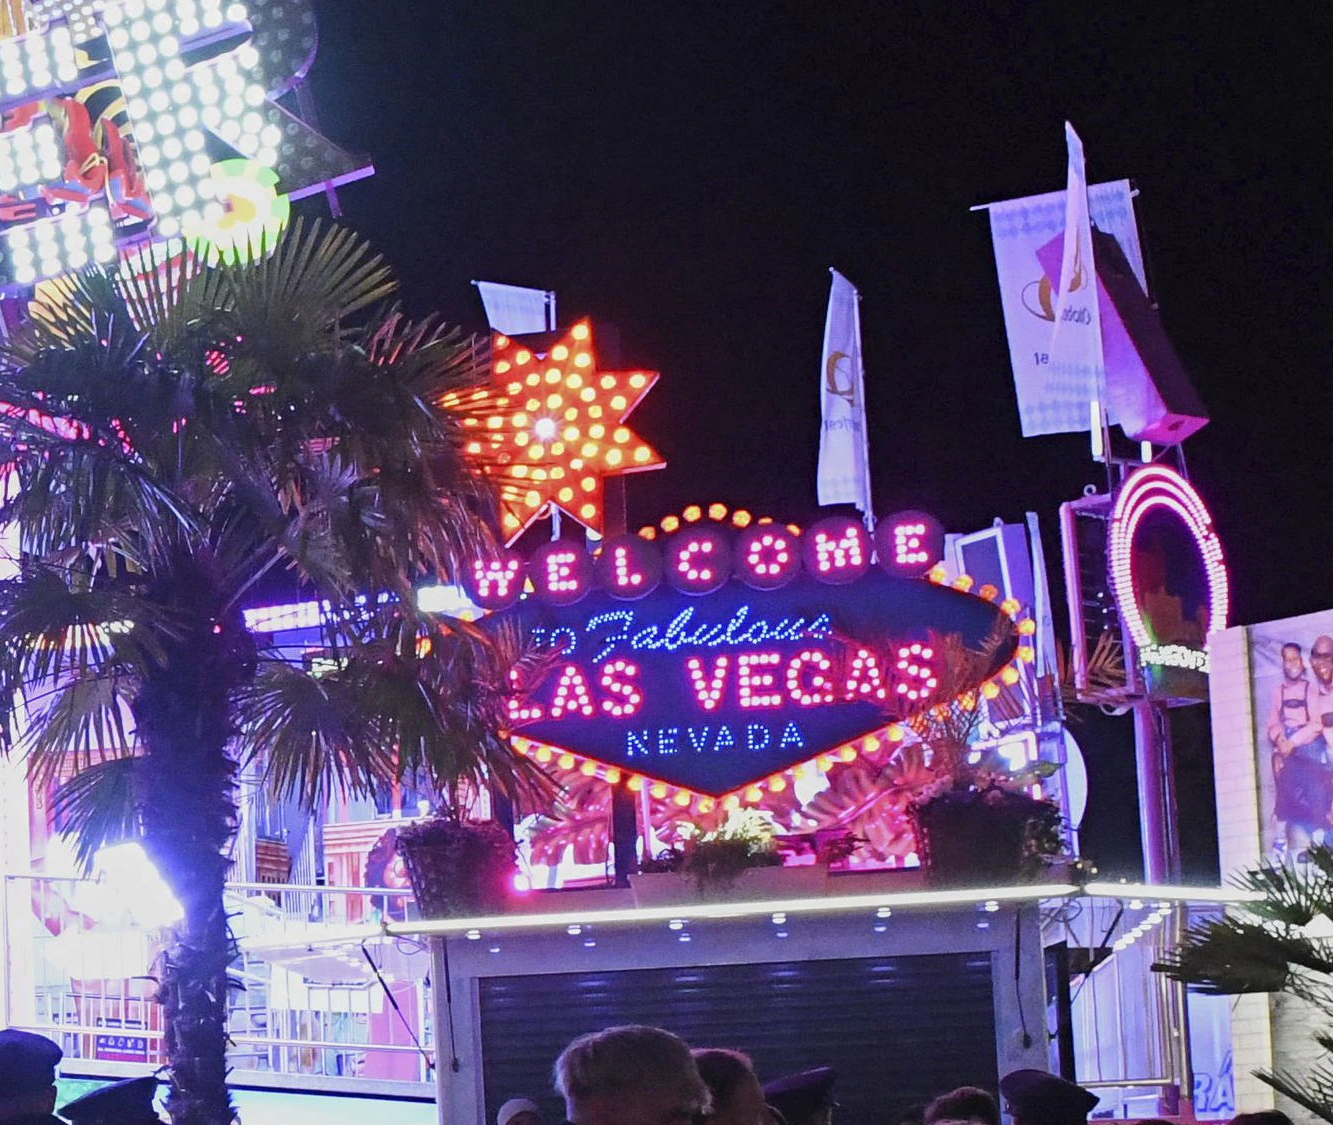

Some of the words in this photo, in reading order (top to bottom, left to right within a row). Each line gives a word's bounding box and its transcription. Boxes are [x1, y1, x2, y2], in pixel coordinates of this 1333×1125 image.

[473, 522, 930, 598] WELCOME
[532, 627, 577, 655] TO
[585, 605, 832, 663] Fabulous
[508, 660, 643, 719] LAS
[687, 642, 937, 710] VEGAS
[625, 722, 804, 756] NEVADA
